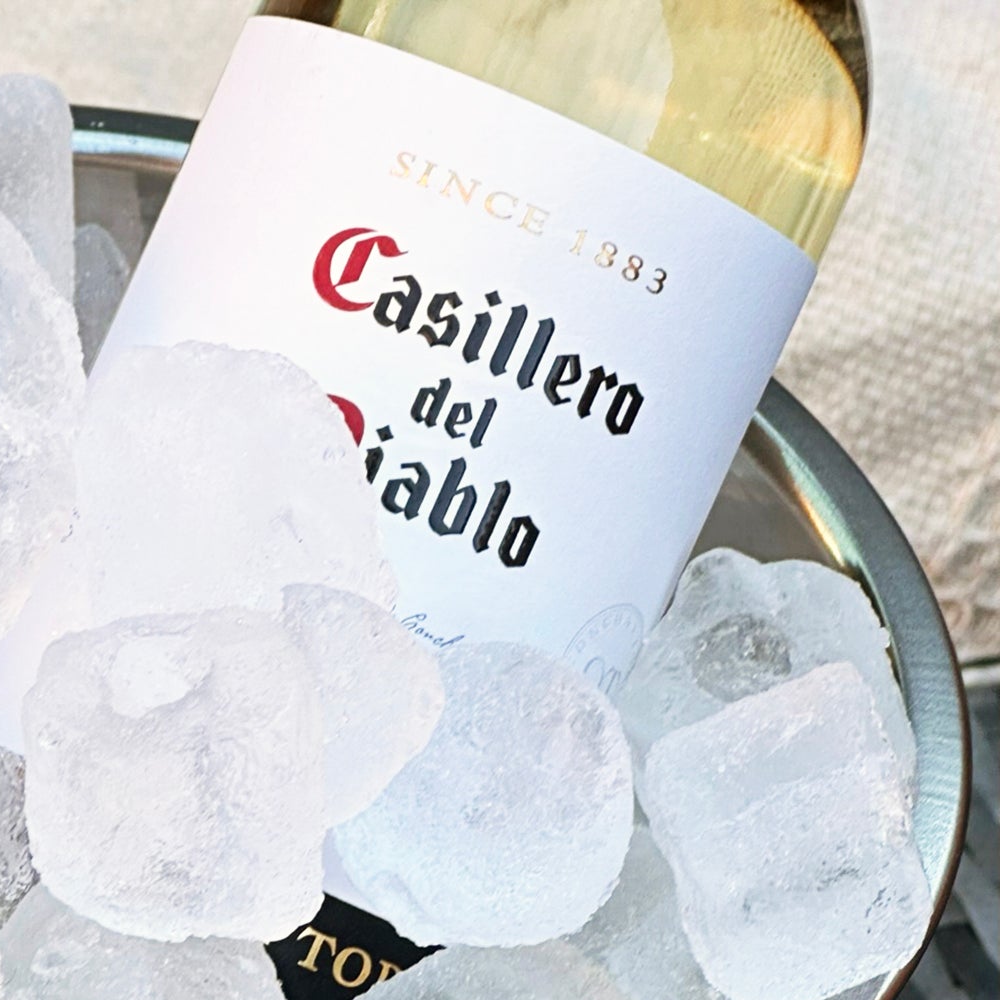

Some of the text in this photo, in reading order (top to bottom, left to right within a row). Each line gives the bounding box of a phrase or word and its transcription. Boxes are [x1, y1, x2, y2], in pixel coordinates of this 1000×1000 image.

[389, 151, 667, 294] SINCE 1883
[312, 227, 644, 435] Casillero
[327, 393, 540, 568] iablo
[410, 377, 497, 449] del
